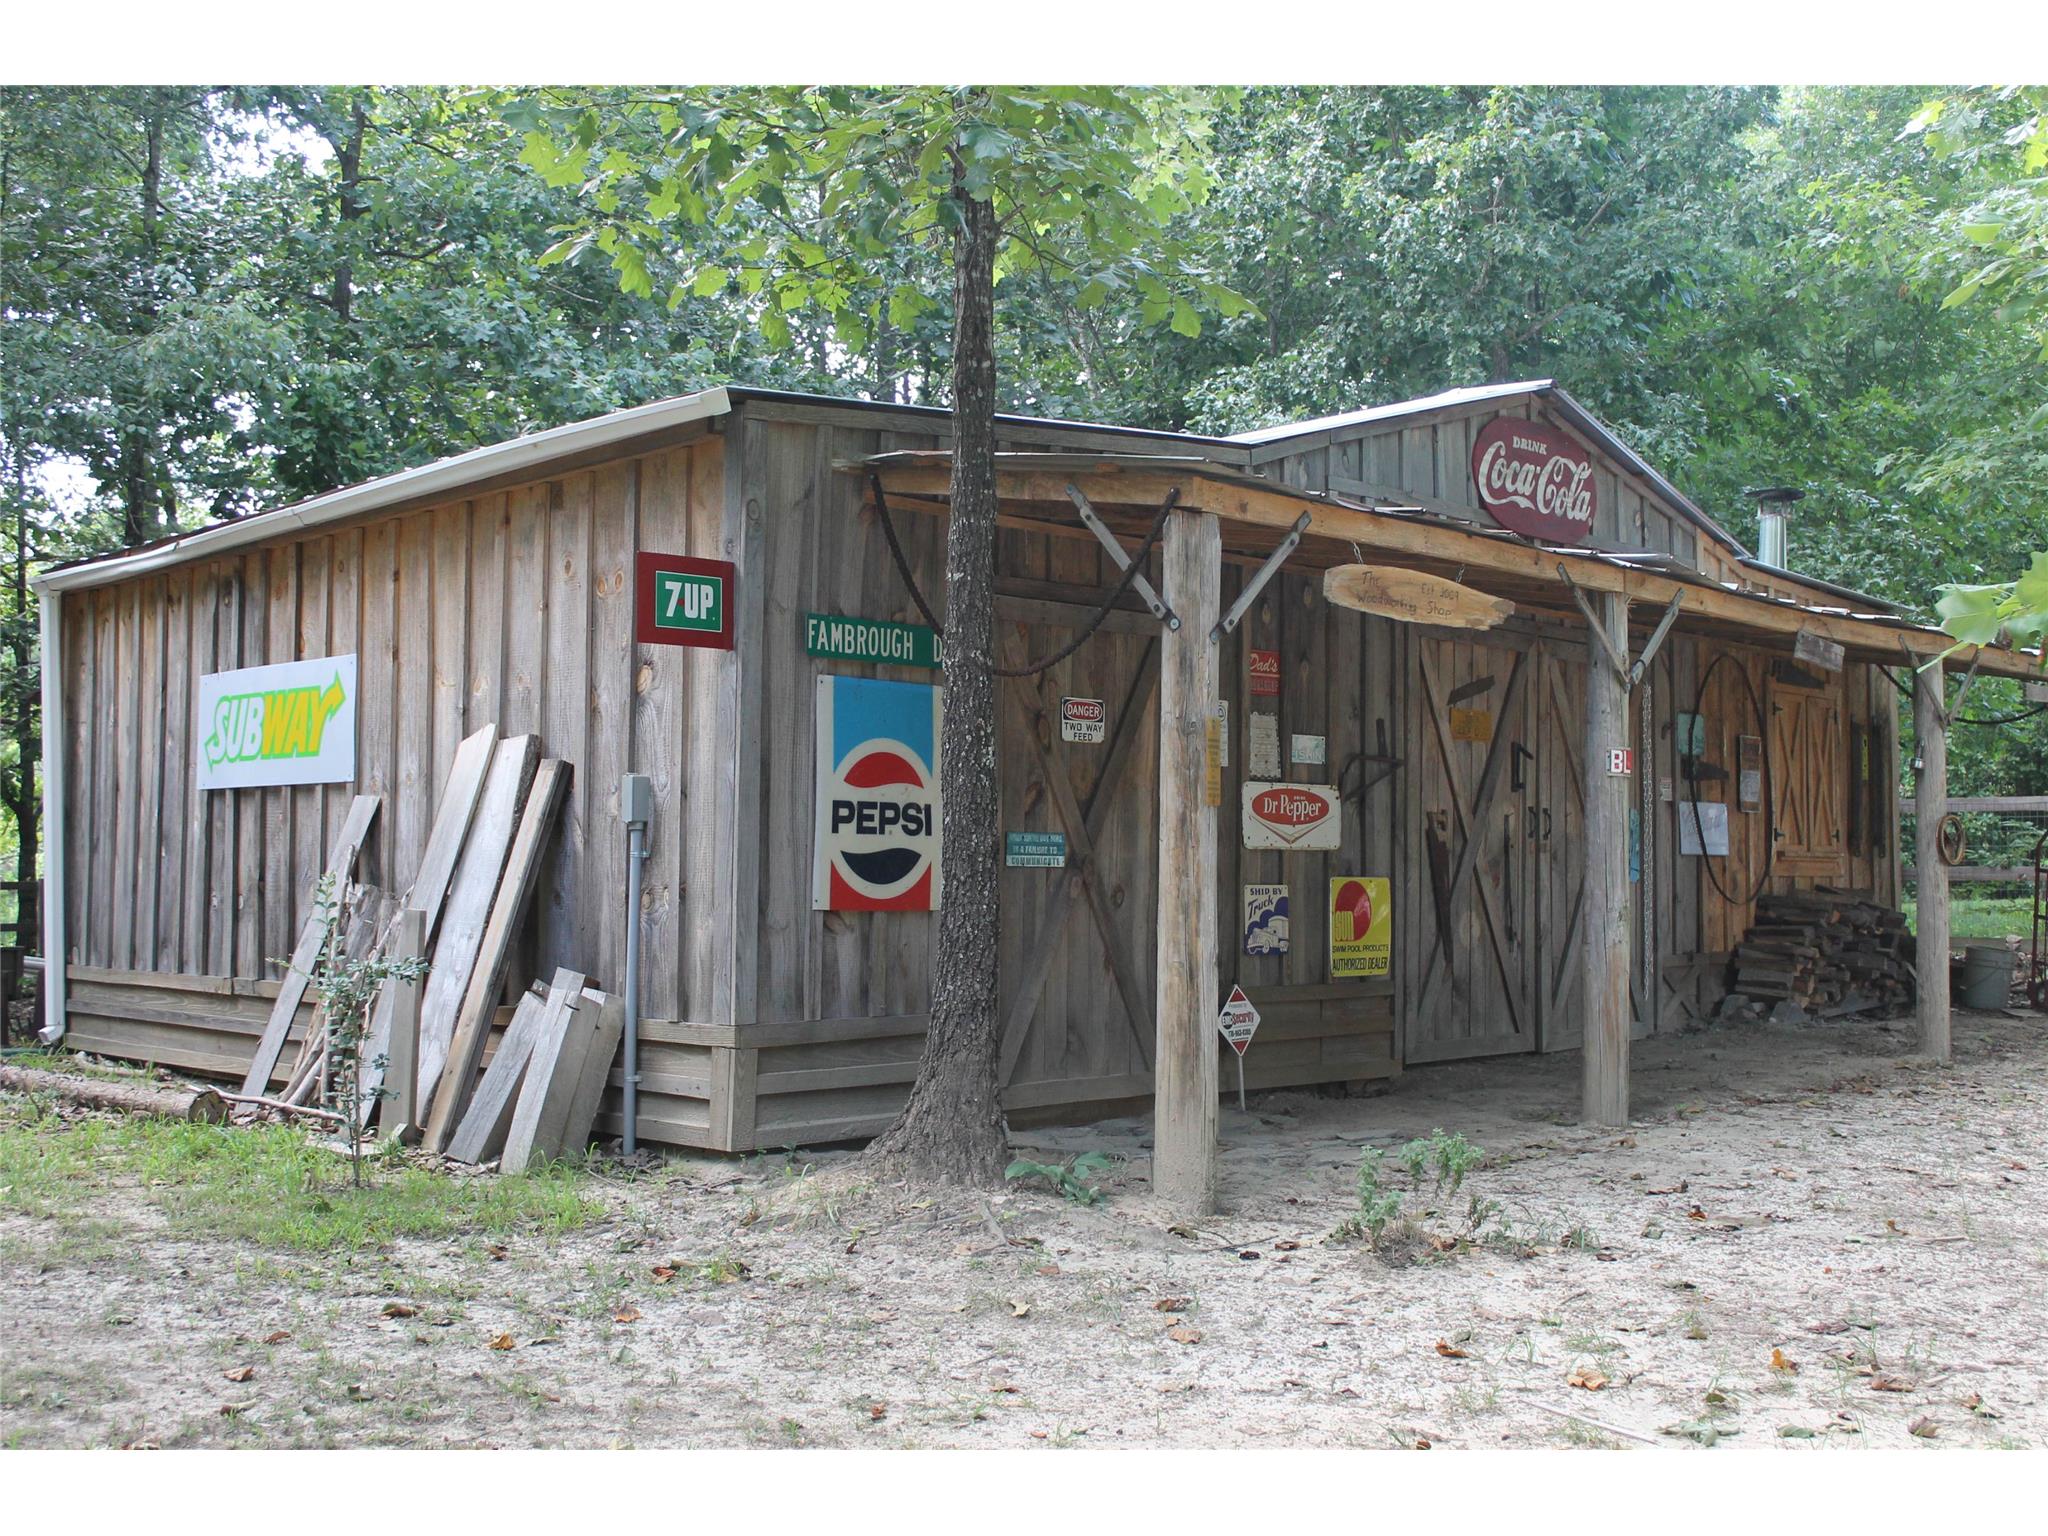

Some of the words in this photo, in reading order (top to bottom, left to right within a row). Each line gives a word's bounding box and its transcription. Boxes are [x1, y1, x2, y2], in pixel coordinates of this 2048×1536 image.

[1513, 435, 1548, 455] DRINK
[1361, 571, 1381, 587] The
[1426, 601, 1453, 620] Shop
[807, 618, 913, 661] FAMBROUGH
[1249, 653, 1279, 672] Dad's
[1066, 704, 1101, 717] DANGER
[204, 669, 346, 775] SUBWAY
[1064, 721, 1083, 732] TWO
[1085, 723, 1103, 733] WAY
[1073, 732, 1093, 742] FEED
[1263, 797, 1278, 814] Dr
[1279, 794, 1322, 822] Pepper
[831, 799, 932, 837] PEPSI
[1272, 887, 1283, 896] BY
[1248, 895, 1274, 921] Truck
[1347, 944, 1361, 953] POOL
[1363, 943, 1389, 952] PRODUCTS
[1332, 957, 1367, 972] AUTHORIZED
[1368, 956, 1388, 970] DEALER
